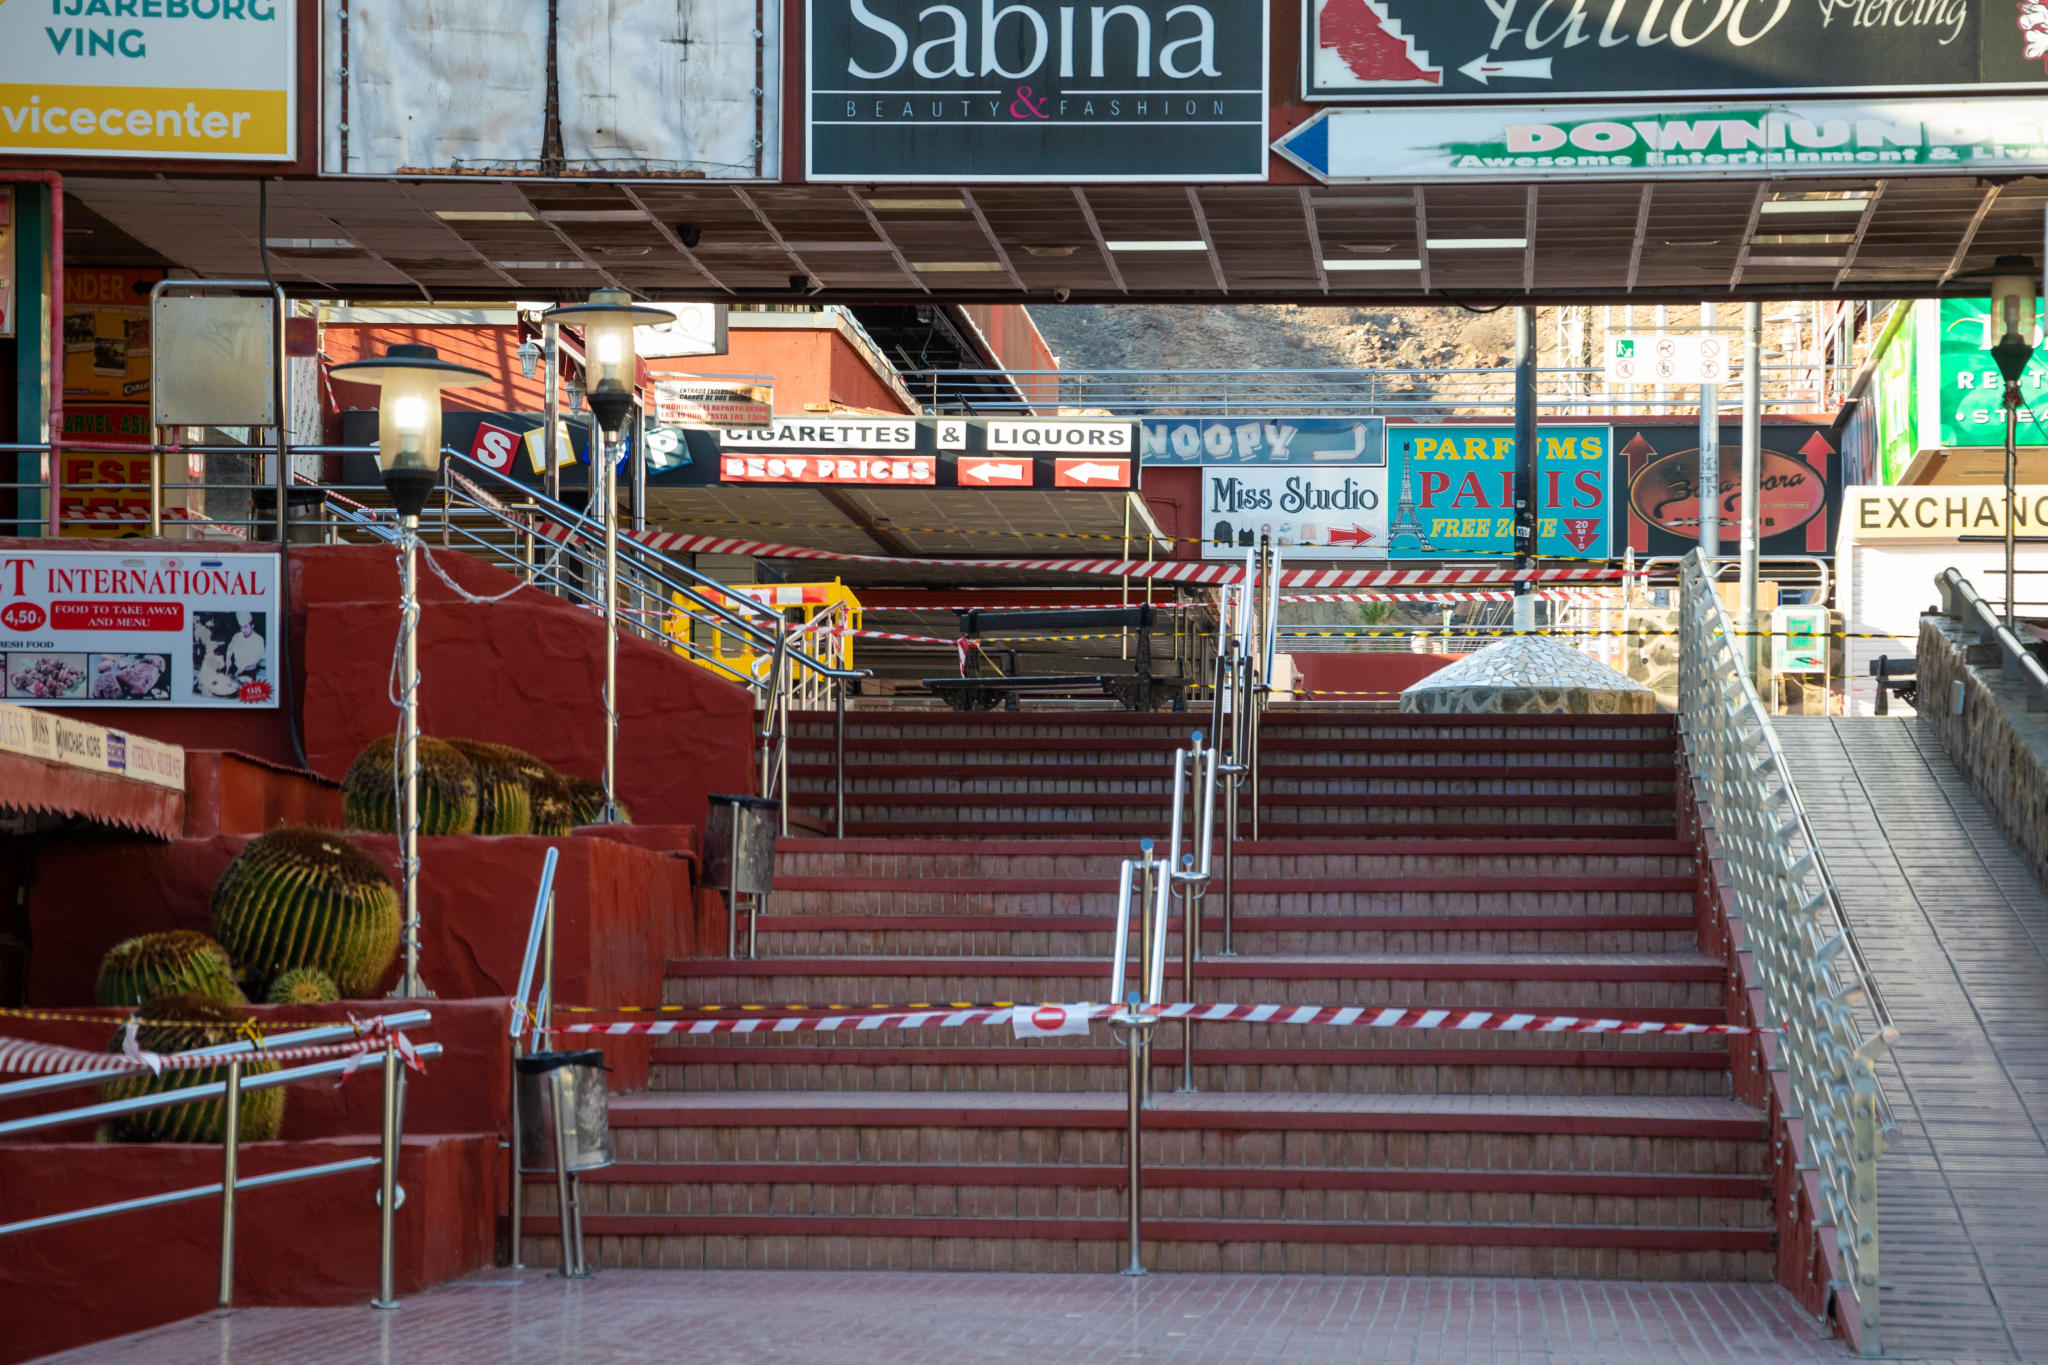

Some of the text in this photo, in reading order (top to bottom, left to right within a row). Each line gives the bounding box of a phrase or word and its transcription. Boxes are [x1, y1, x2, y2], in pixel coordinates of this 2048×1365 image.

[44, 27, 146, 58] VING
[847, 0, 1223, 79] Sabina
[847, 85, 1224, 119] BEAUTY & FASHION
[1, 95, 251, 138] vicecenter
[1506, 117, 2048, 153] DOWNUNDE
[1457, 154, 1633, 168] Awesome
[1646, 147, 1917, 166] Entertainment
[1928, 146, 1961, 160] &
[1957, 370, 2046, 390] RET
[661, 403, 701, 411] PROHIBIDO
[661, 411, 675, 419] LAS
[726, 426, 1125, 446] CIGARETTES & LIQUORS
[1414, 437, 1603, 460] PARFMS
[727, 459, 930, 479] BEST PRICES
[1211, 476, 1379, 513] Miss Studio
[1430, 518, 1490, 538] FREE
[1495, 518, 1558, 538] ZE
[1575, 520, 1589, 529] 20
[47, 568, 266, 596] INTERNATIONAL
[55, 604, 180, 616] FOOD TO TAKE AWAY
[88, 617, 151, 628] AND MENU
[26, 641, 55, 649] FOOD
[246, 686, 262, 696] 98
[0, 709, 26, 748] UESS
[31, 714, 50, 746] BOSS
[62, 729, 86, 757] MICHAEL
